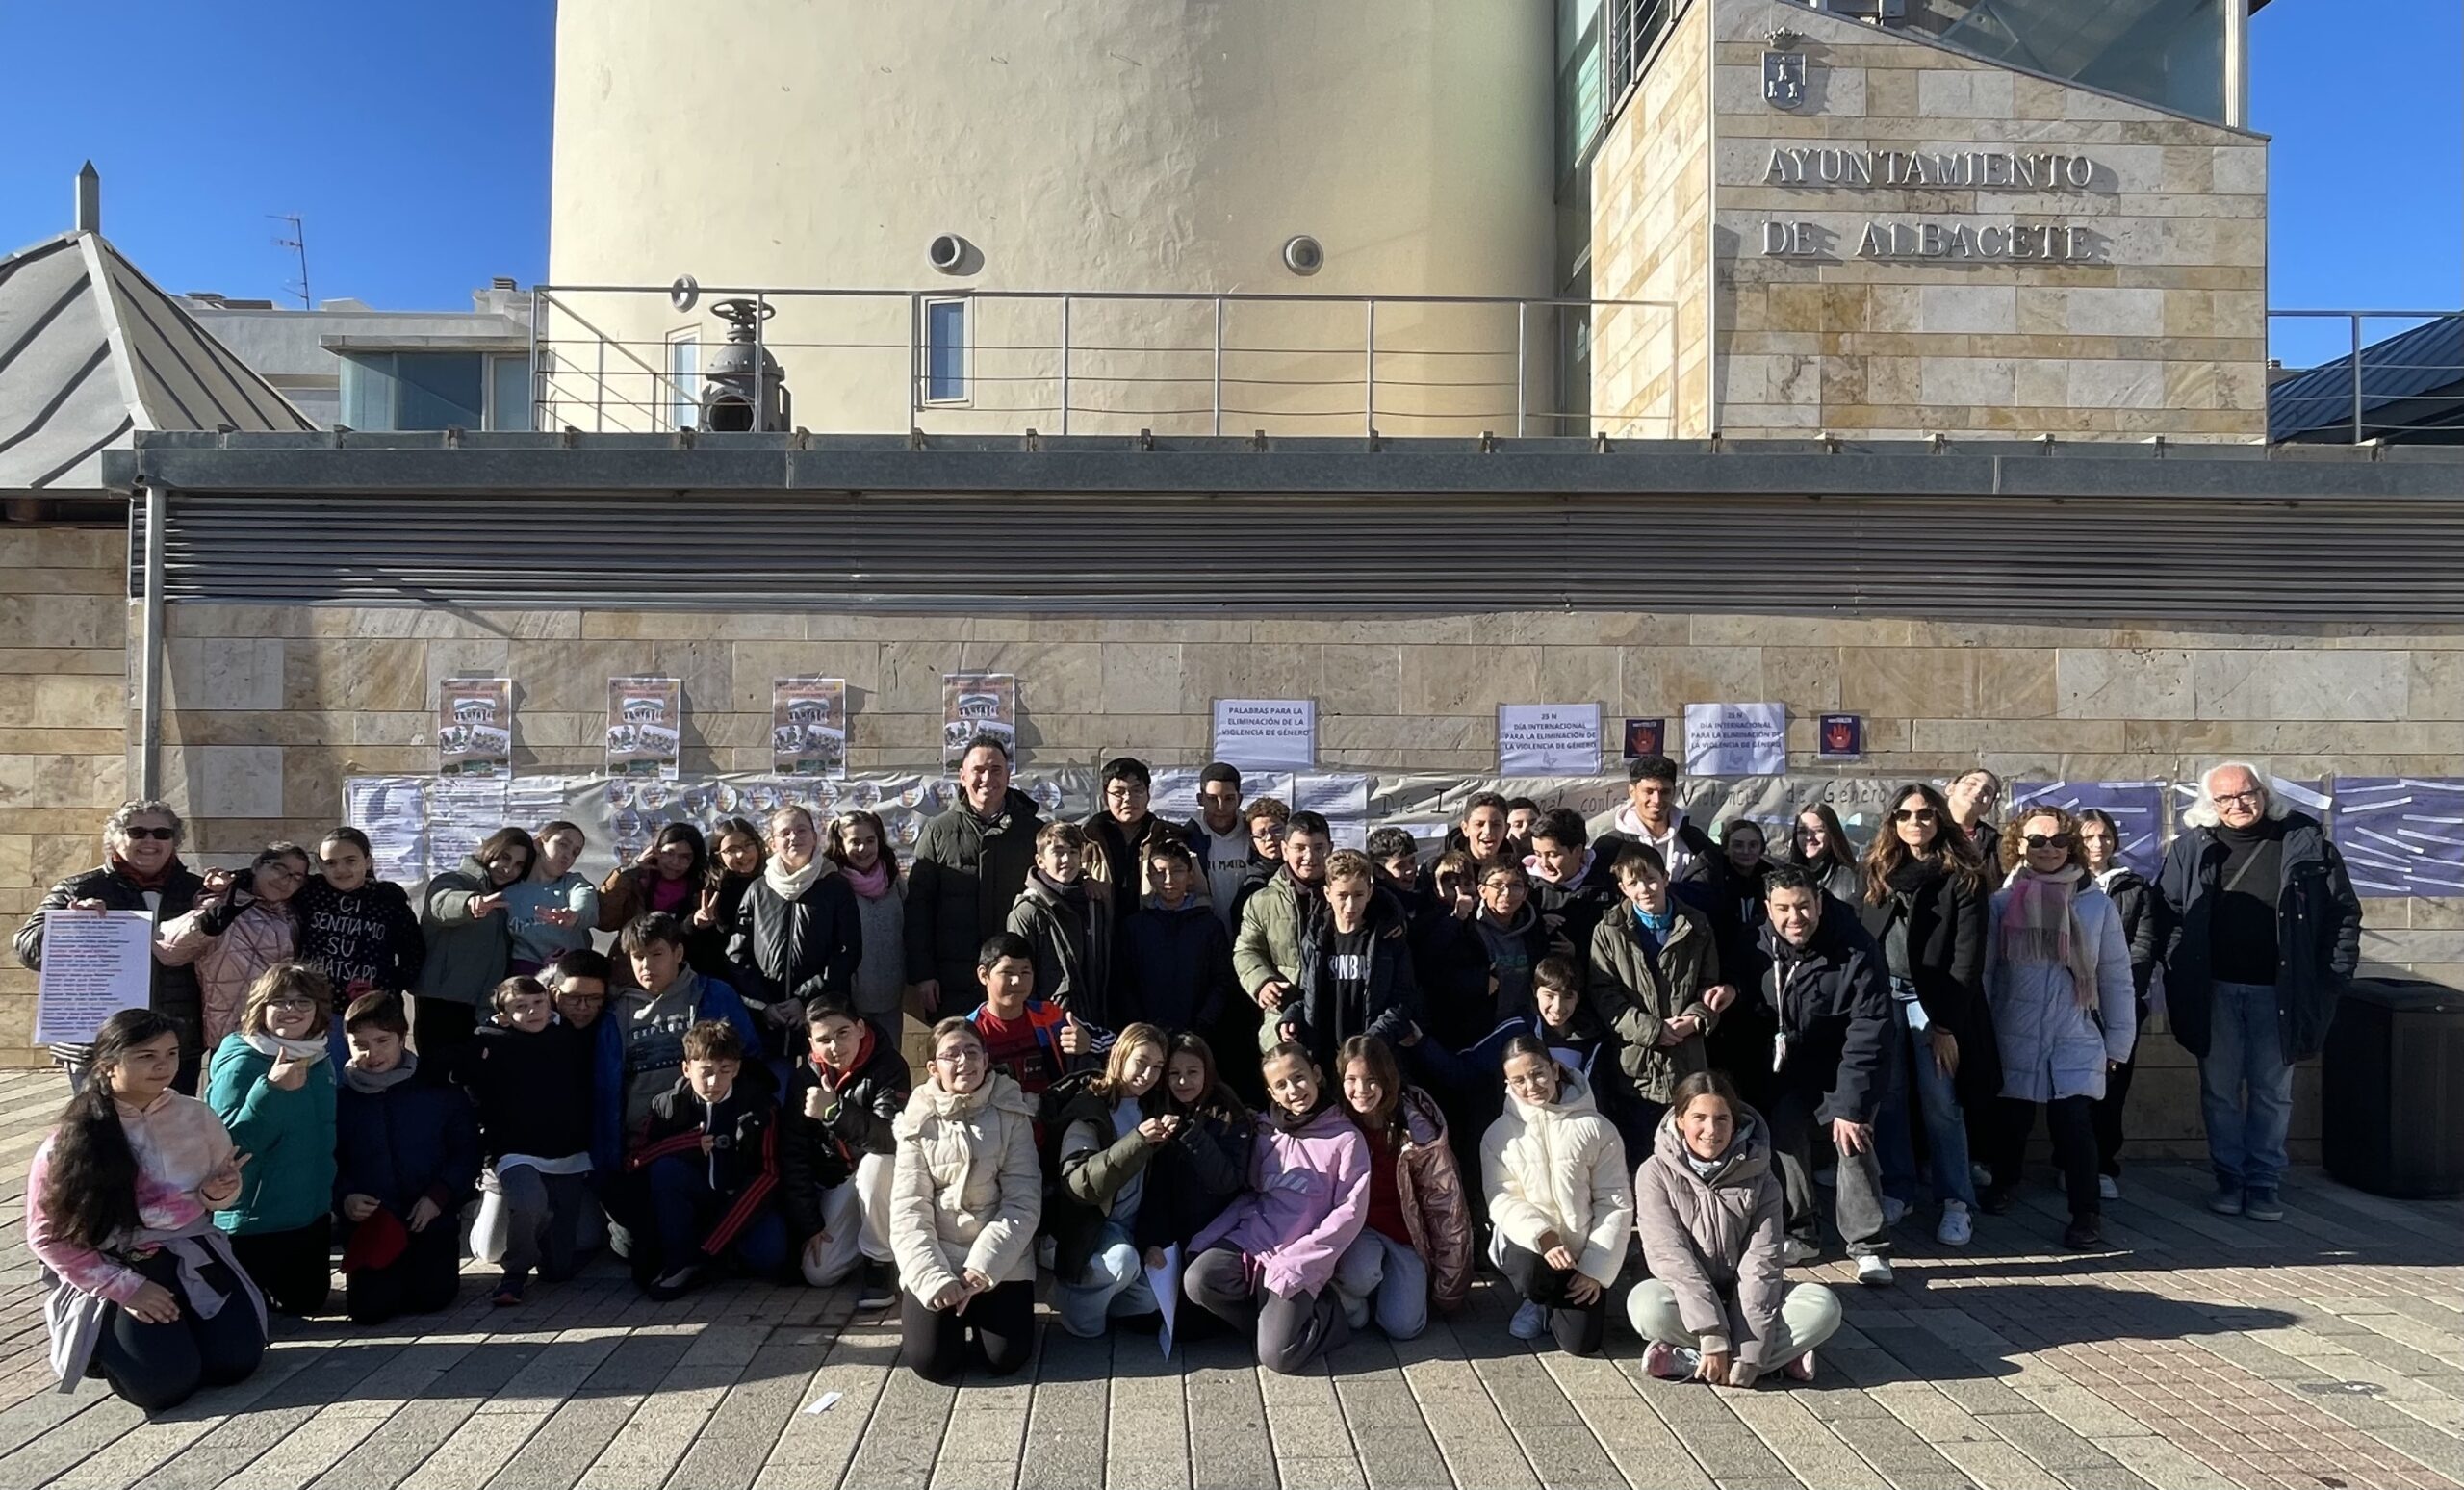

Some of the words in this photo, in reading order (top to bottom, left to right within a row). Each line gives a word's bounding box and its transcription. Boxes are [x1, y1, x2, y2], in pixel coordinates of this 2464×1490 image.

[1762, 146, 2094, 190] AYUNTAMIENTO
[1761, 219, 1818, 256] DE
[1855, 220, 2092, 261] ALBACETE
[1537, 731, 1586, 739] ELIMINACIÓN
[1379, 792, 1416, 816] Día
[1786, 782, 1807, 803] de
[1823, 780, 1887, 805] Género
[339, 895, 362, 913] CI
[310, 911, 387, 940] SENTIAMO
[322, 936, 357, 958] SU
[1338, 954, 1367, 980] NBA
